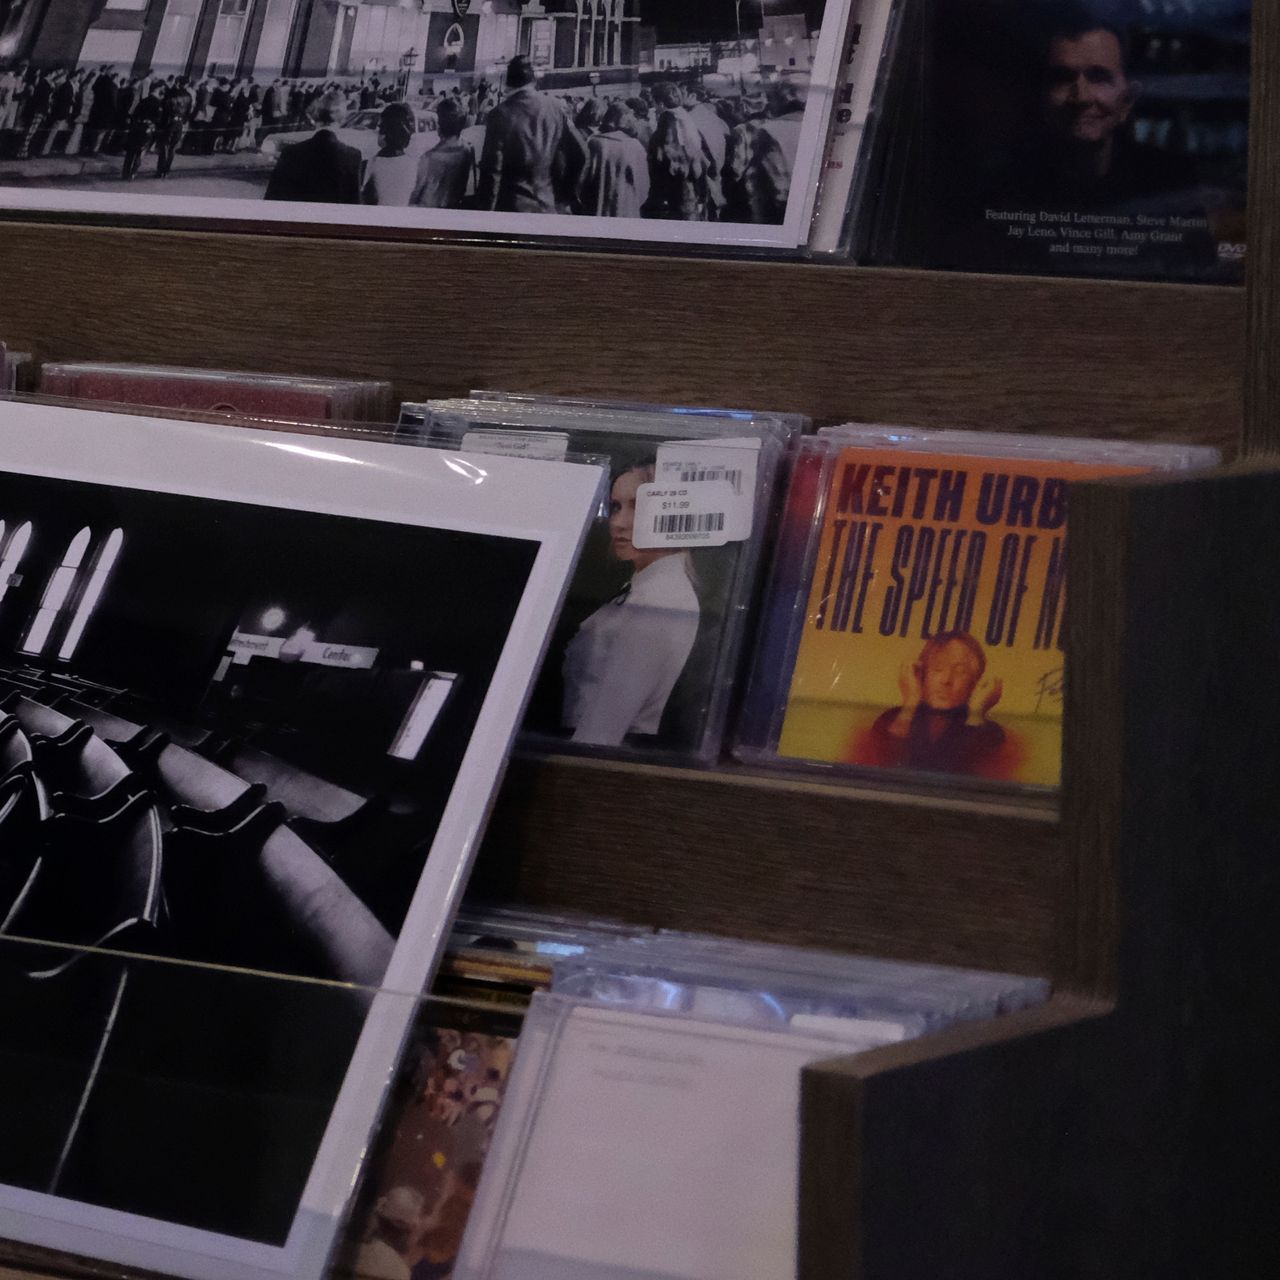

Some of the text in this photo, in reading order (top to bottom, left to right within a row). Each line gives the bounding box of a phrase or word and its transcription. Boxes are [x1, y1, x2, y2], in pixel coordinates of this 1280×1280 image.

[985, 209, 1036, 224] Featuring
[1040, 210, 1071, 223] David
[1136, 214, 1168, 226] Steve
[1008, 225, 1024, 238] Jay
[1060, 227, 1091, 239] Vince
[1121, 230, 1146, 243] Amy
[1150, 231, 1183, 243] Grant
[1049, 242, 1070, 254] and
[1072, 245, 1104, 257] many
[1218, 243, 1247, 254] DVD
[836, 463, 968, 522] KEITH
[662, 501, 690, 509] $11.99
[815, 520, 884, 633] THE
[878, 524, 988, 640] SPEED
[985, 533, 1037, 647] OF
